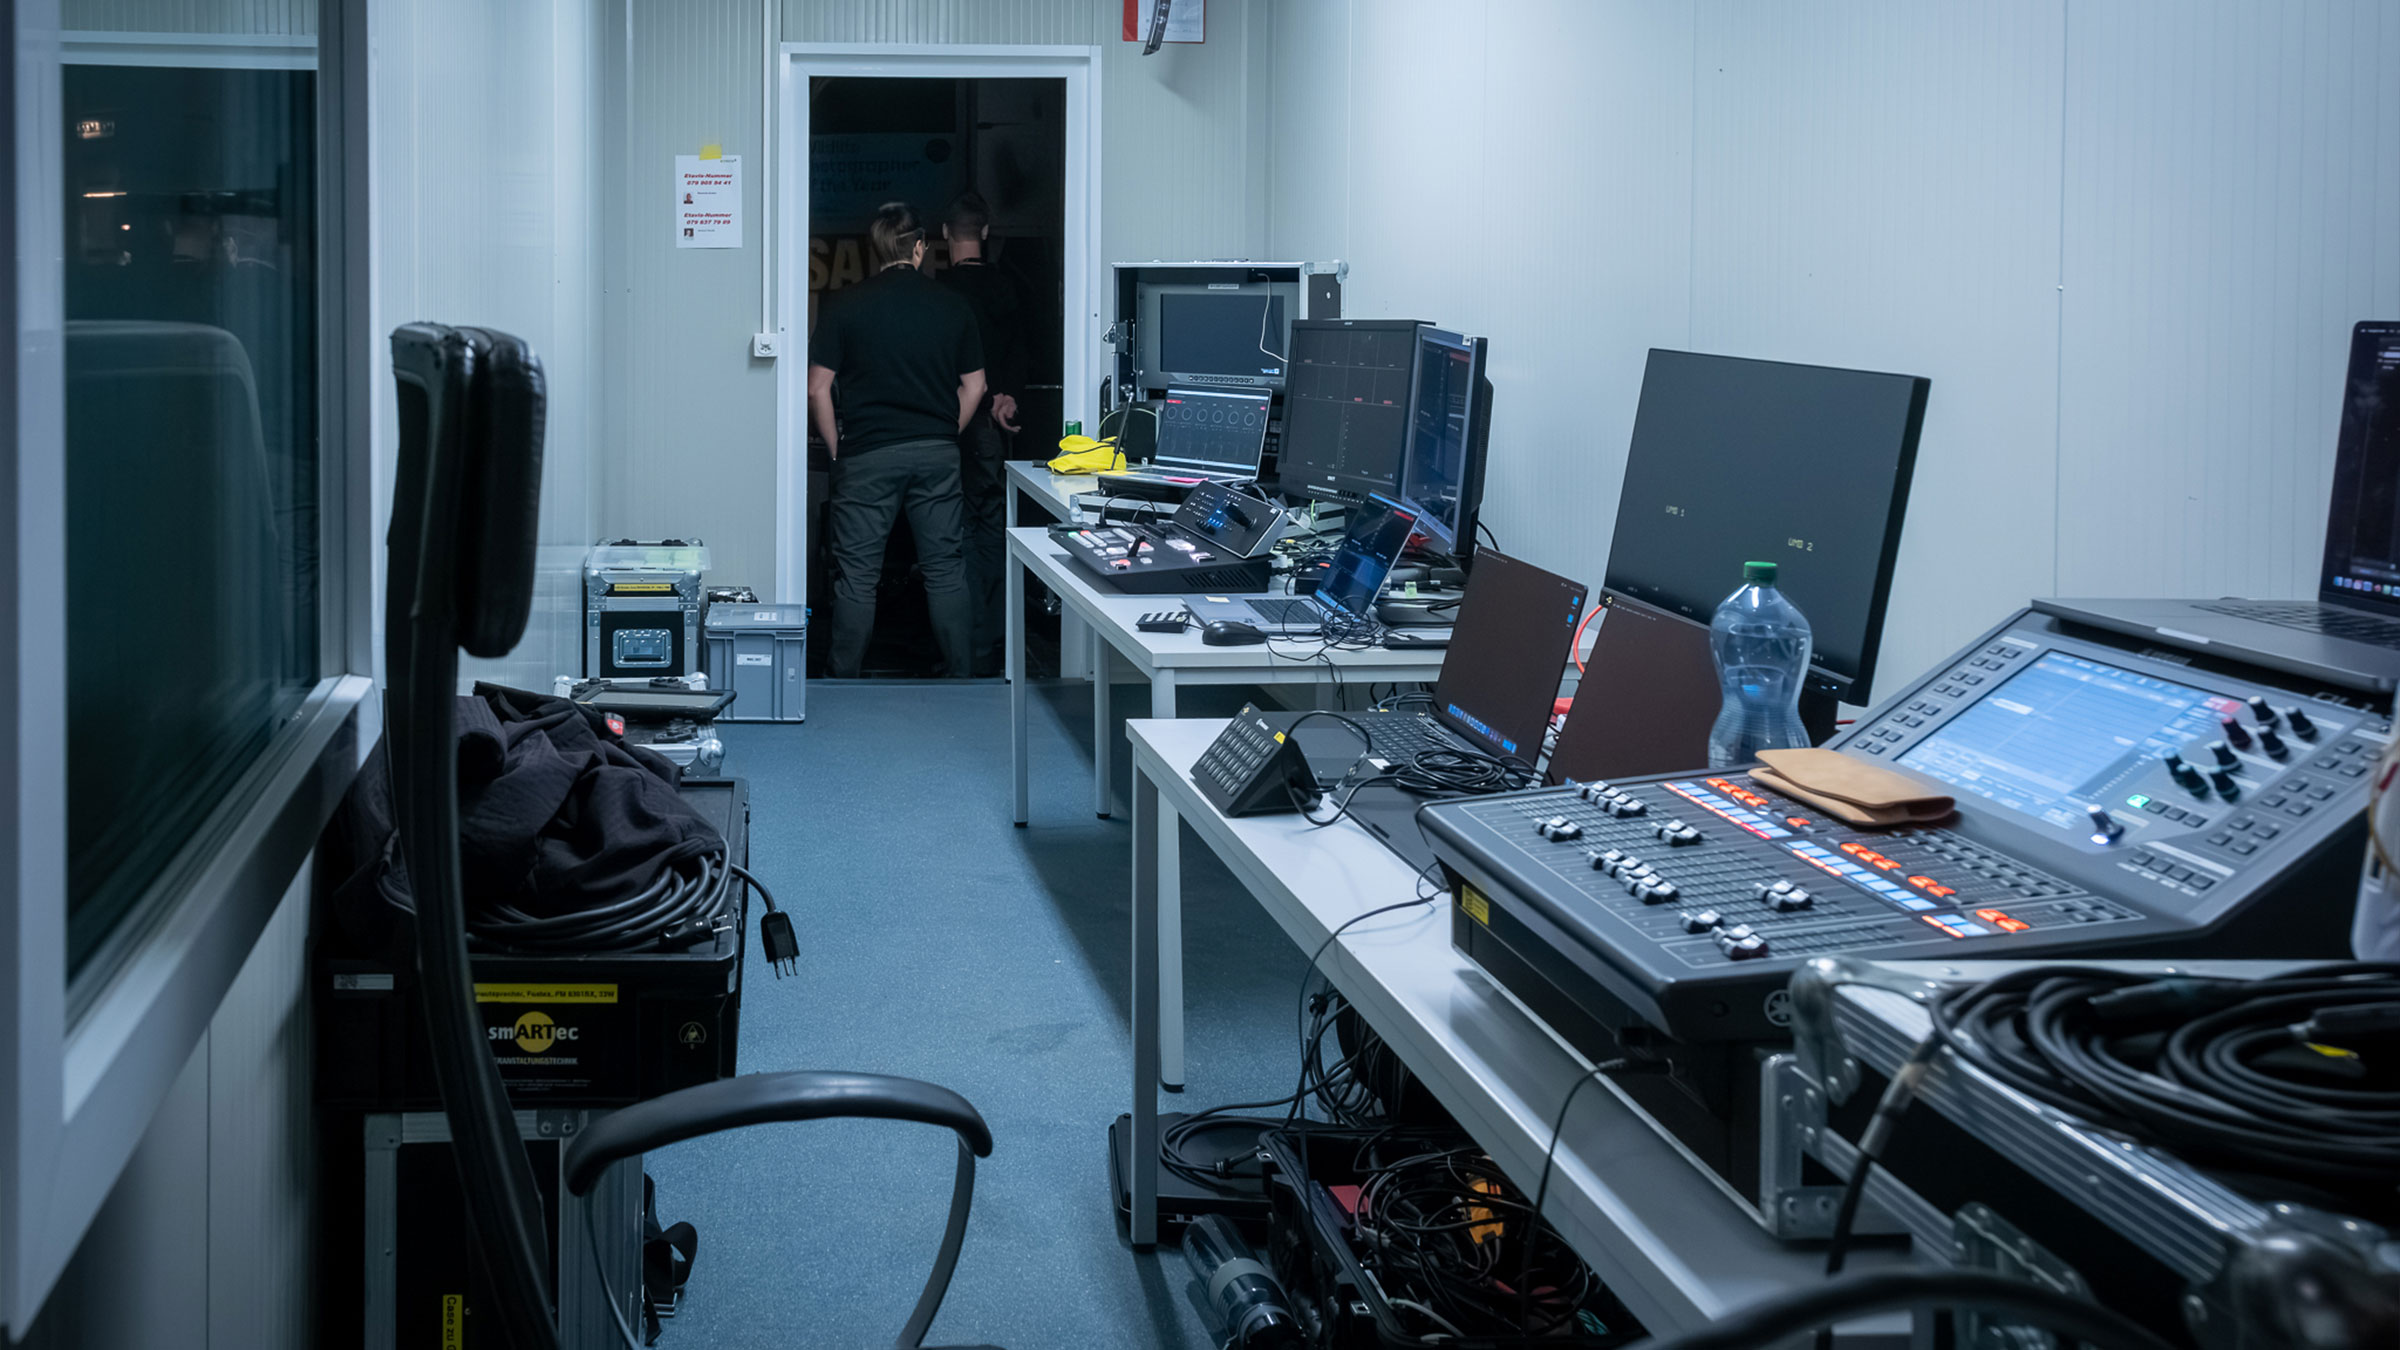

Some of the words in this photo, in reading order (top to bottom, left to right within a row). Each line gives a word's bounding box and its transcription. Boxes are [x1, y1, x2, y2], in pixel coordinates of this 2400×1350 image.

[1806, 542, 1814, 552] 2
[488, 1023, 579, 1041] smARTec
[447, 1297, 456, 1325] Case
